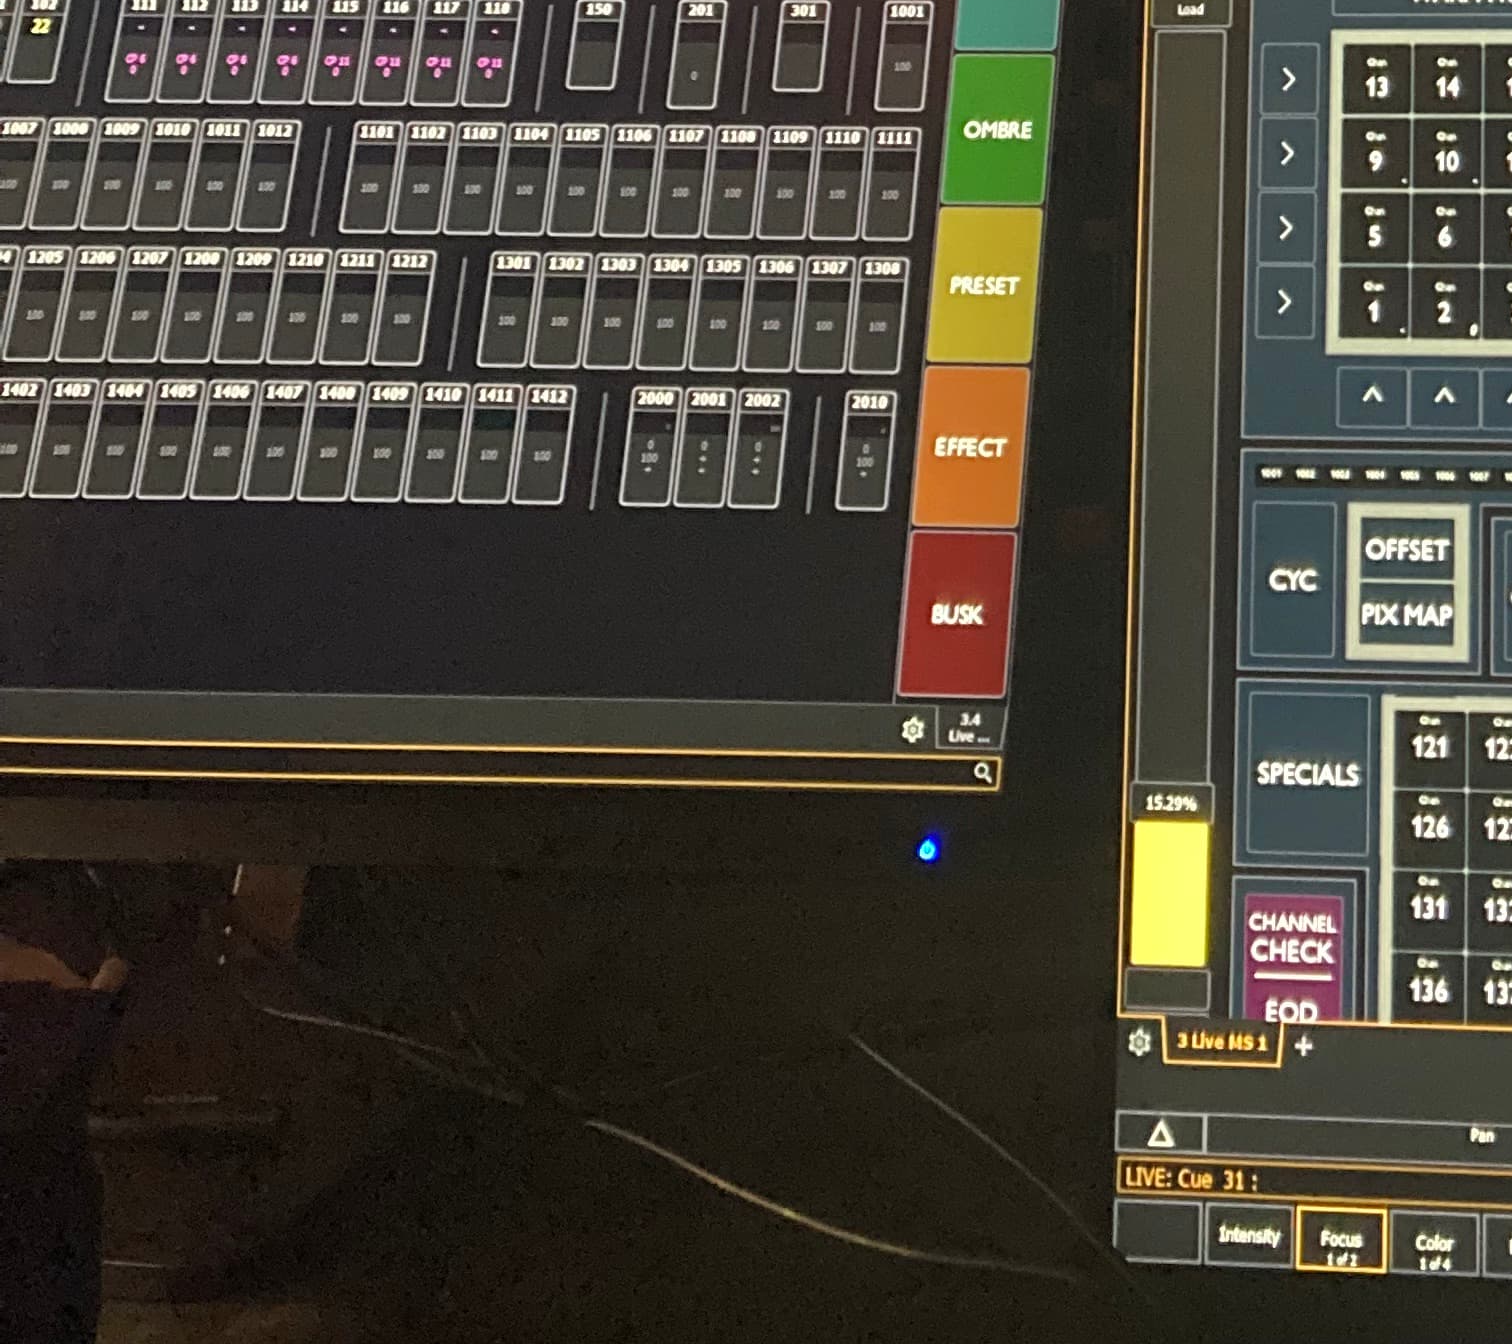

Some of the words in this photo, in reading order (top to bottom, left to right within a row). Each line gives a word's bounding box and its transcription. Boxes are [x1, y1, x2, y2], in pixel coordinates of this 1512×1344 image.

[689, 4, 713, 16] 201
[1366, 76, 1388, 98] 13
[360, 125, 393, 138] 1101
[964, 121, 1032, 139] OMBRE
[392, 254, 427, 268] 1212
[549, 257, 584, 270] 1302
[812, 261, 848, 274] 1307
[950, 276, 1020, 295] PRESET
[1368, 300, 1379, 322] 1
[479, 388, 513, 402] 1411
[852, 395, 888, 409] 2010
[935, 437, 1007, 457] EFFECT
[1366, 537, 1450, 561] OFFSET
[1269, 568, 1317, 591] CYC
[932, 604, 983, 624] BUSK
[1362, 603, 1399, 625] PIX
[1404, 603, 1453, 626] MAP
[960, 713, 980, 726] 3.4
[949, 730, 974, 742] Live
[1413, 734, 1448, 758] 121
[1258, 761, 1360, 786] SPECIALS
[1147, 794, 1197, 811] 15.29%
[1249, 912, 1337, 933] CHANNEL
[1251, 938, 1334, 963] CHECK
[1265, 999, 1318, 1023] EOD
[1178, 1032, 1188, 1048] 3
[1192, 1031, 1224, 1049] Live
[1228, 1033, 1254, 1050] MS
[1257, 1035, 1267, 1051] 1
[1471, 1128, 1495, 1144] Pan
[1126, 1167, 1171, 1187] LIVE:
[1178, 1168, 1213, 1189] Cue
[1224, 1170, 1244, 1190] 31
[1219, 1224, 1281, 1248] Intensity
[1321, 1229, 1363, 1248] Focus
[1416, 1233, 1455, 1252] Color
